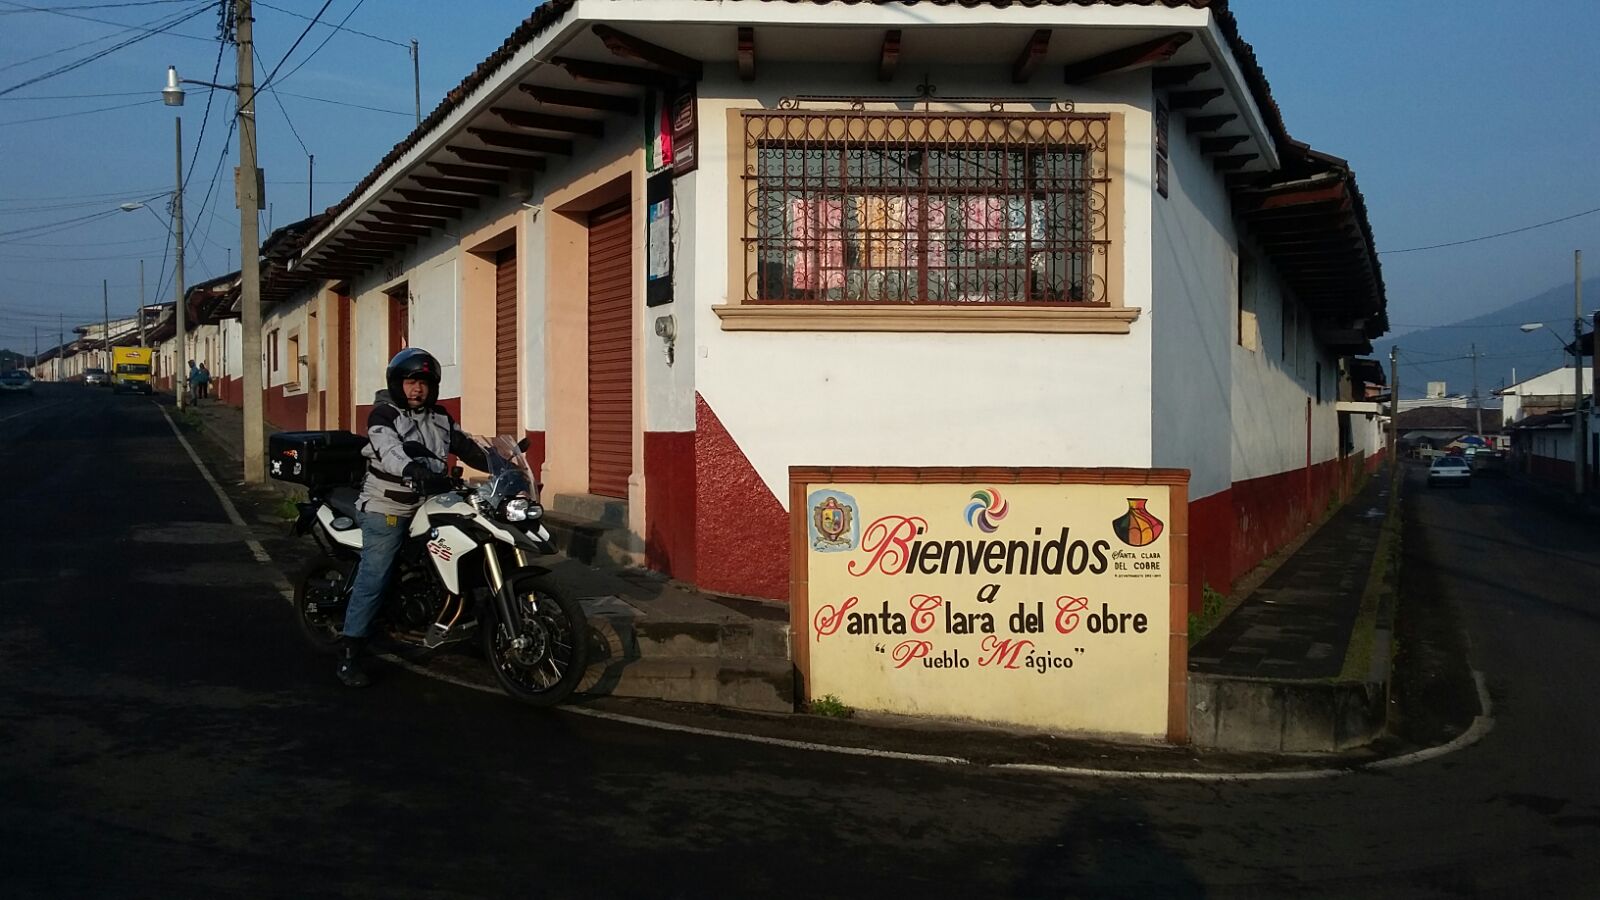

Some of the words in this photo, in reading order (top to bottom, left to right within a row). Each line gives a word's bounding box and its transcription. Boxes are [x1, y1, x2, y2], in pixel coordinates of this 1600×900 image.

[848, 515, 1111, 576] Bienvenidos
[1112, 549, 1136, 560] SANTA
[1114, 561, 1127, 570] DEL
[1133, 561, 1160, 570] COBRE
[977, 583, 1001, 604] a
[814, 596, 907, 642] Santa
[909, 593, 995, 635] Clara
[1008, 602, 1044, 634] del
[1055, 595, 1148, 635] Cobre
